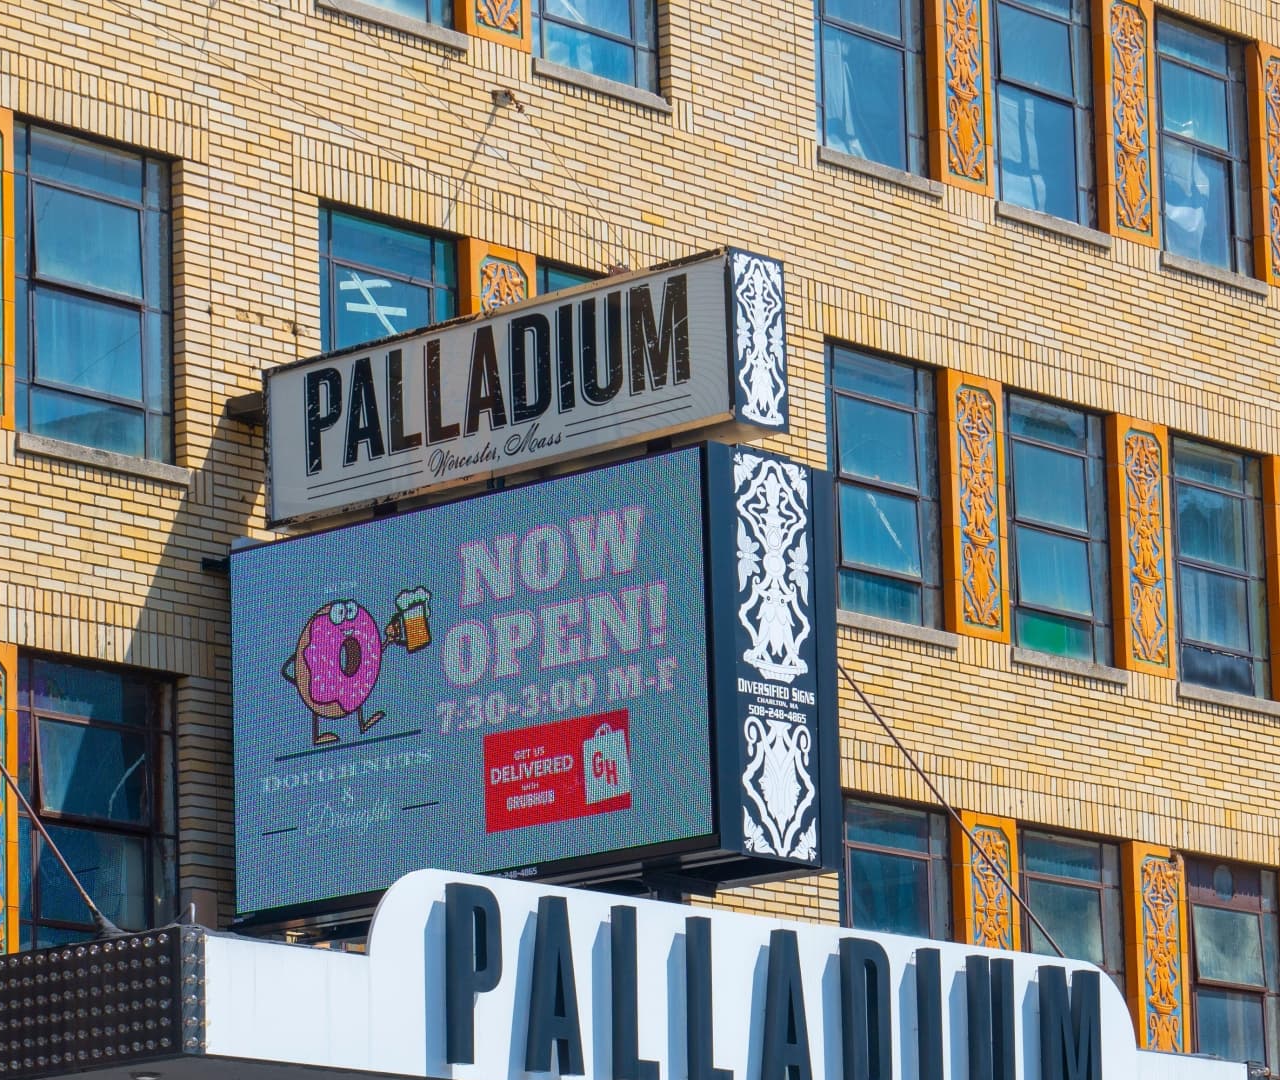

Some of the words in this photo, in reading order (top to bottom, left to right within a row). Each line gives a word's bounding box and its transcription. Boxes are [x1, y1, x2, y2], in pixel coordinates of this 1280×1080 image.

[304, 273, 690, 477] PALLADIUM
[428, 442, 501, 477] Worcester,
[504, 423, 562, 456] Mass
[460, 506, 643, 607] NOW
[443, 581, 667, 687] OPEN!
[436, 674, 596, 734] 7:30-3:00
[606, 657, 677, 702] M-F
[738, 678, 789, 700] DIVERSIFIED
[792, 688, 815, 705] SIGNS
[748, 704, 806, 724] 508-248-4865
[490, 755, 574, 785] DELIVERED
[534, 746, 545, 757] US
[593, 751, 618, 786] GH
